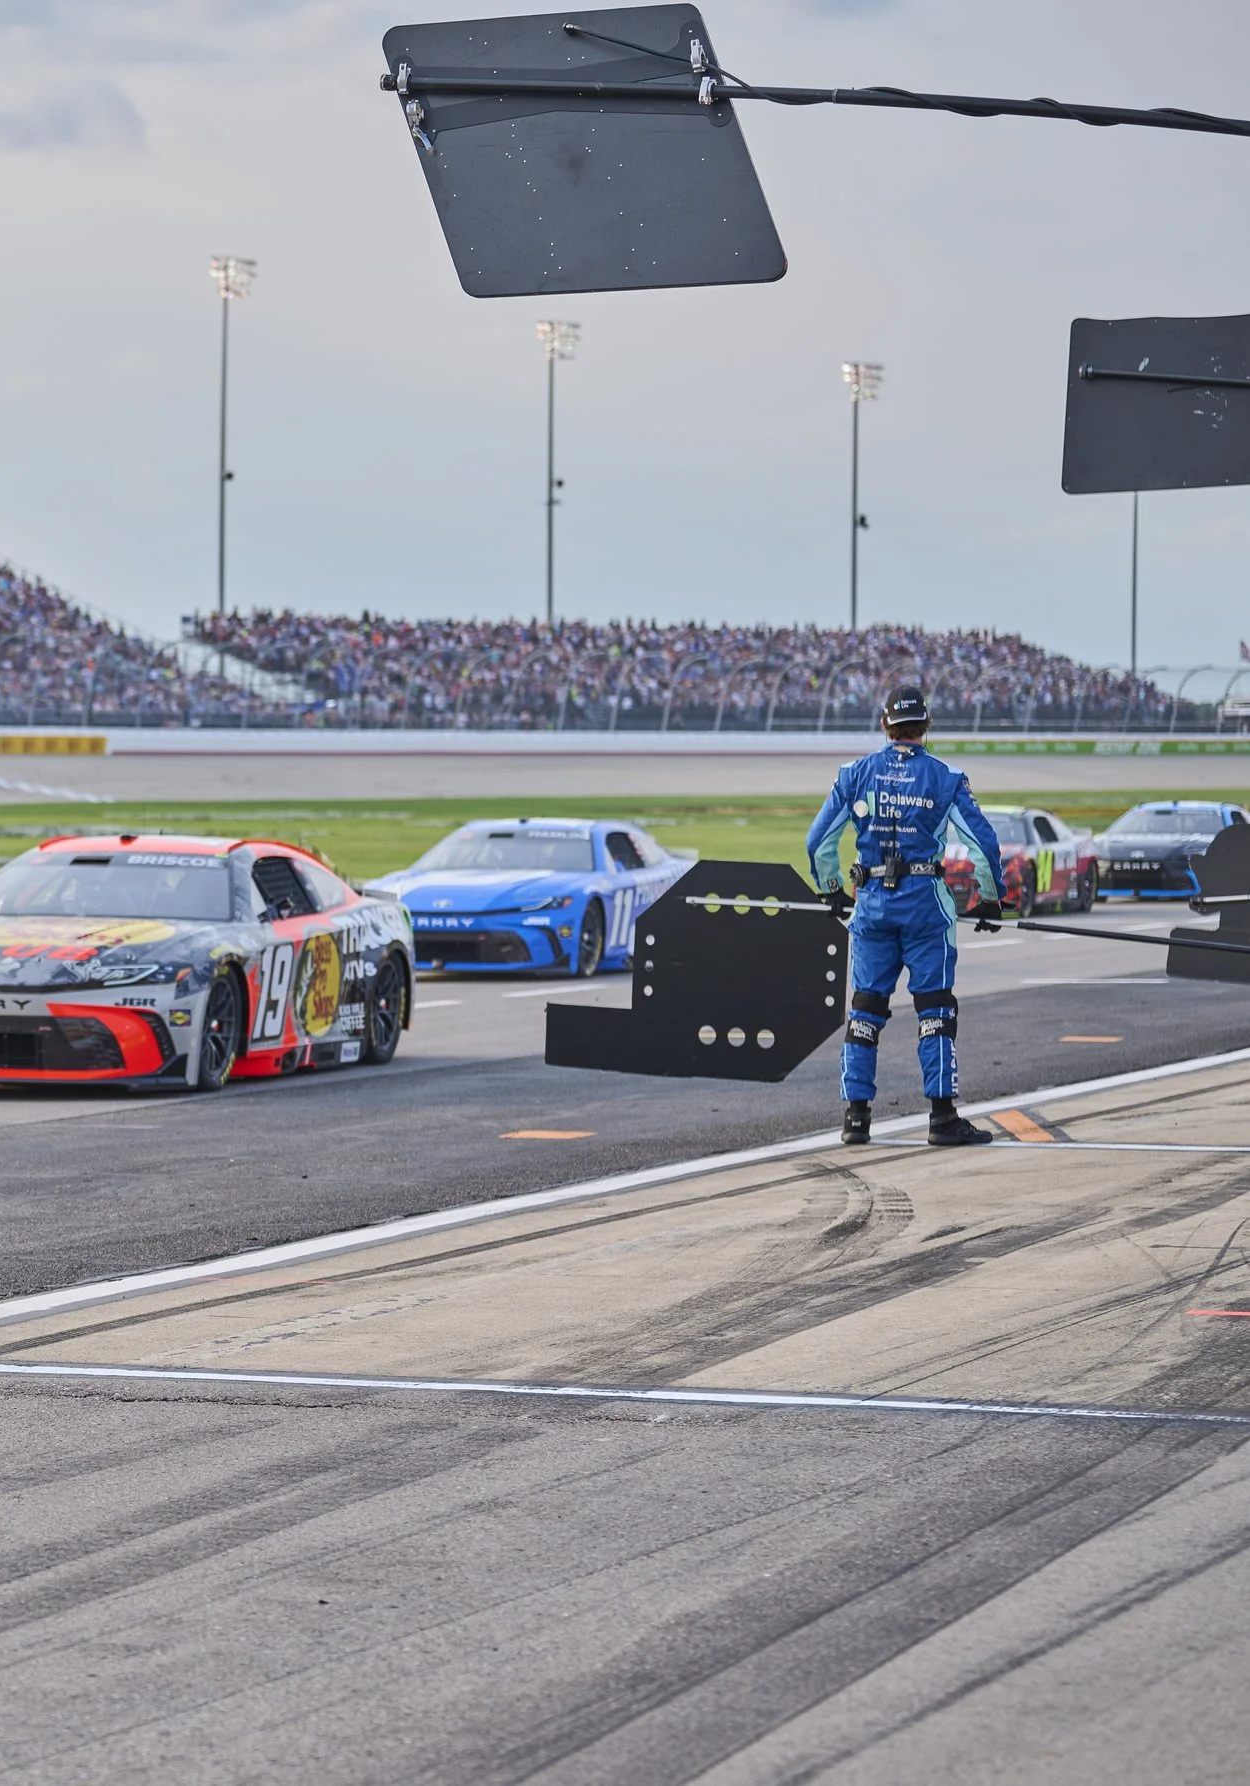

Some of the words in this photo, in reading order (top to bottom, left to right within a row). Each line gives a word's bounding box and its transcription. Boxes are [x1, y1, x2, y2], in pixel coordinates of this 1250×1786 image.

[879, 791, 934, 809] Delaware
[879, 805, 902, 819] Life
[127, 854, 224, 868] BRISCOE
[411, 916, 475, 928] AMRY
[609, 889, 634, 948] 11
[344, 958, 378, 982] ATVs
[252, 943, 295, 1040] 19
[114, 997, 158, 1008] JGR
